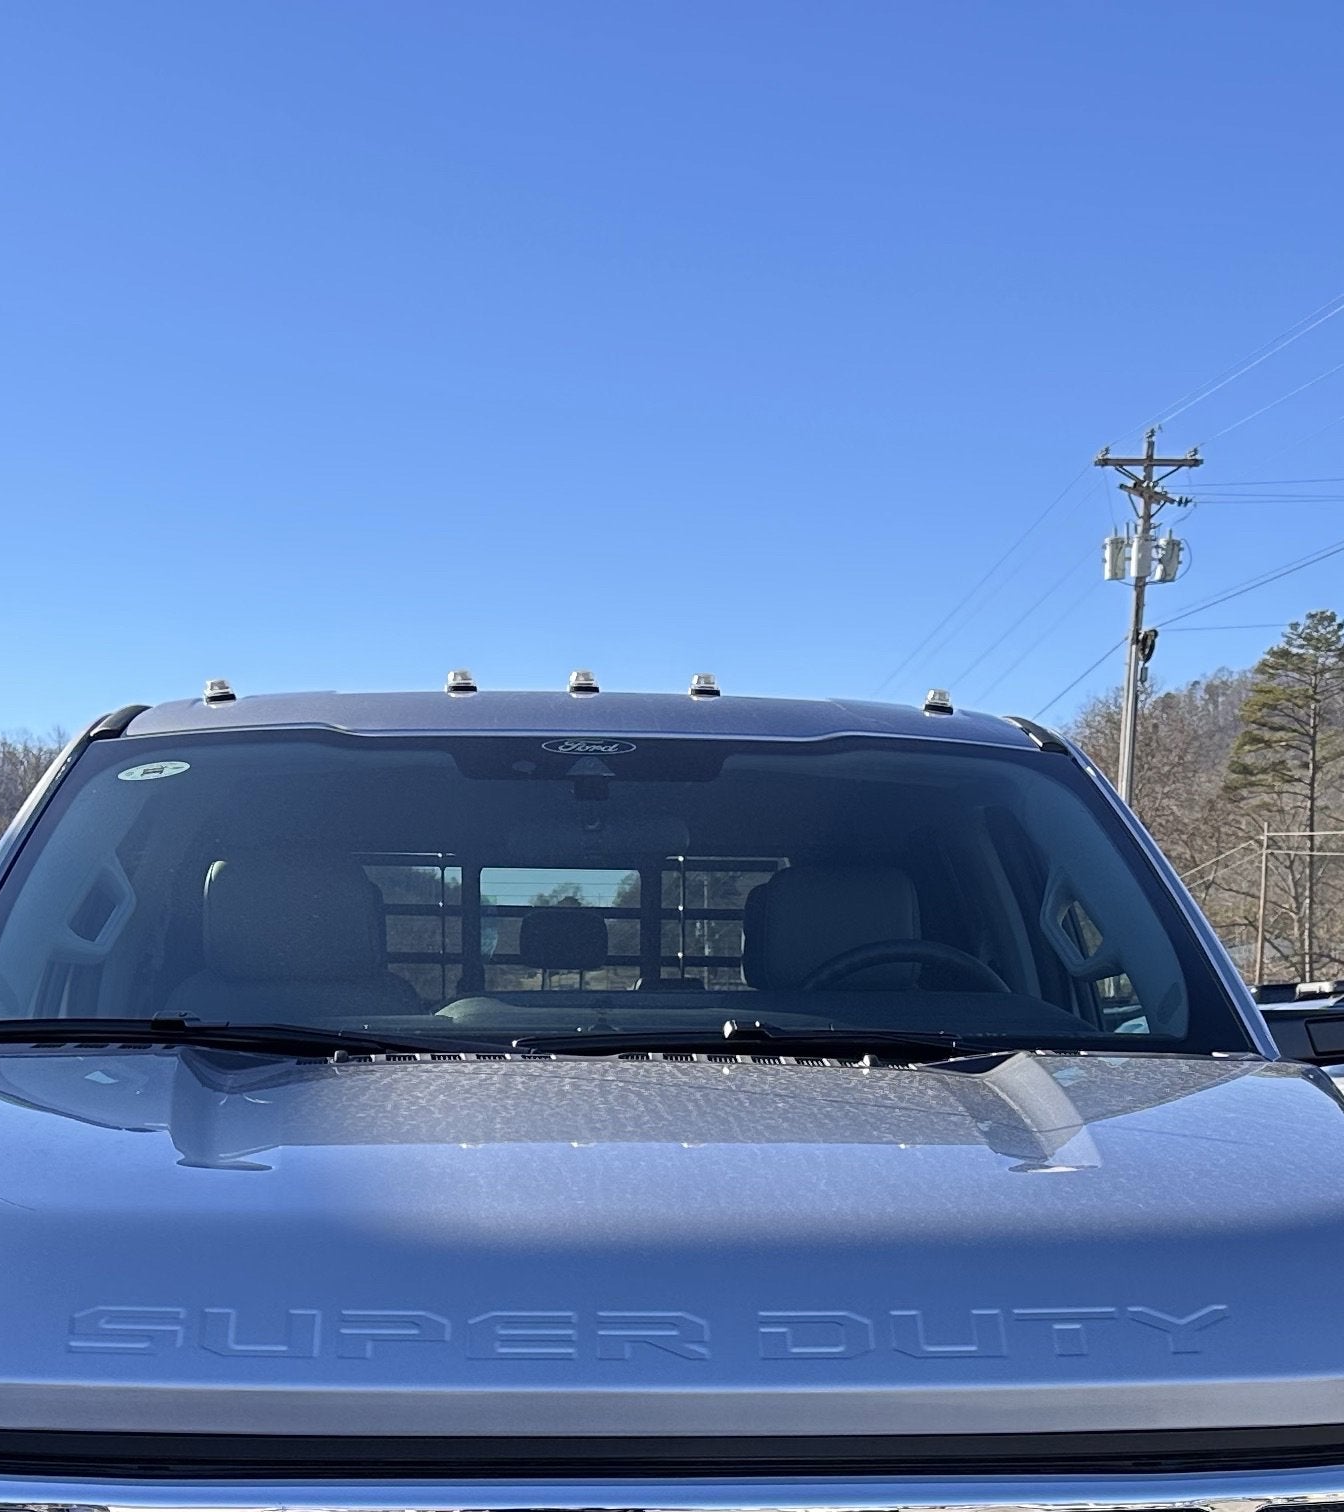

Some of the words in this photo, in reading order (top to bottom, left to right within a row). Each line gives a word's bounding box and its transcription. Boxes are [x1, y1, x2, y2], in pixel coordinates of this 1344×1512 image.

[558, 740, 619, 752] Ford
[66, 1305, 712, 1363] SUPER
[757, 1303, 1231, 1362] DUTY
